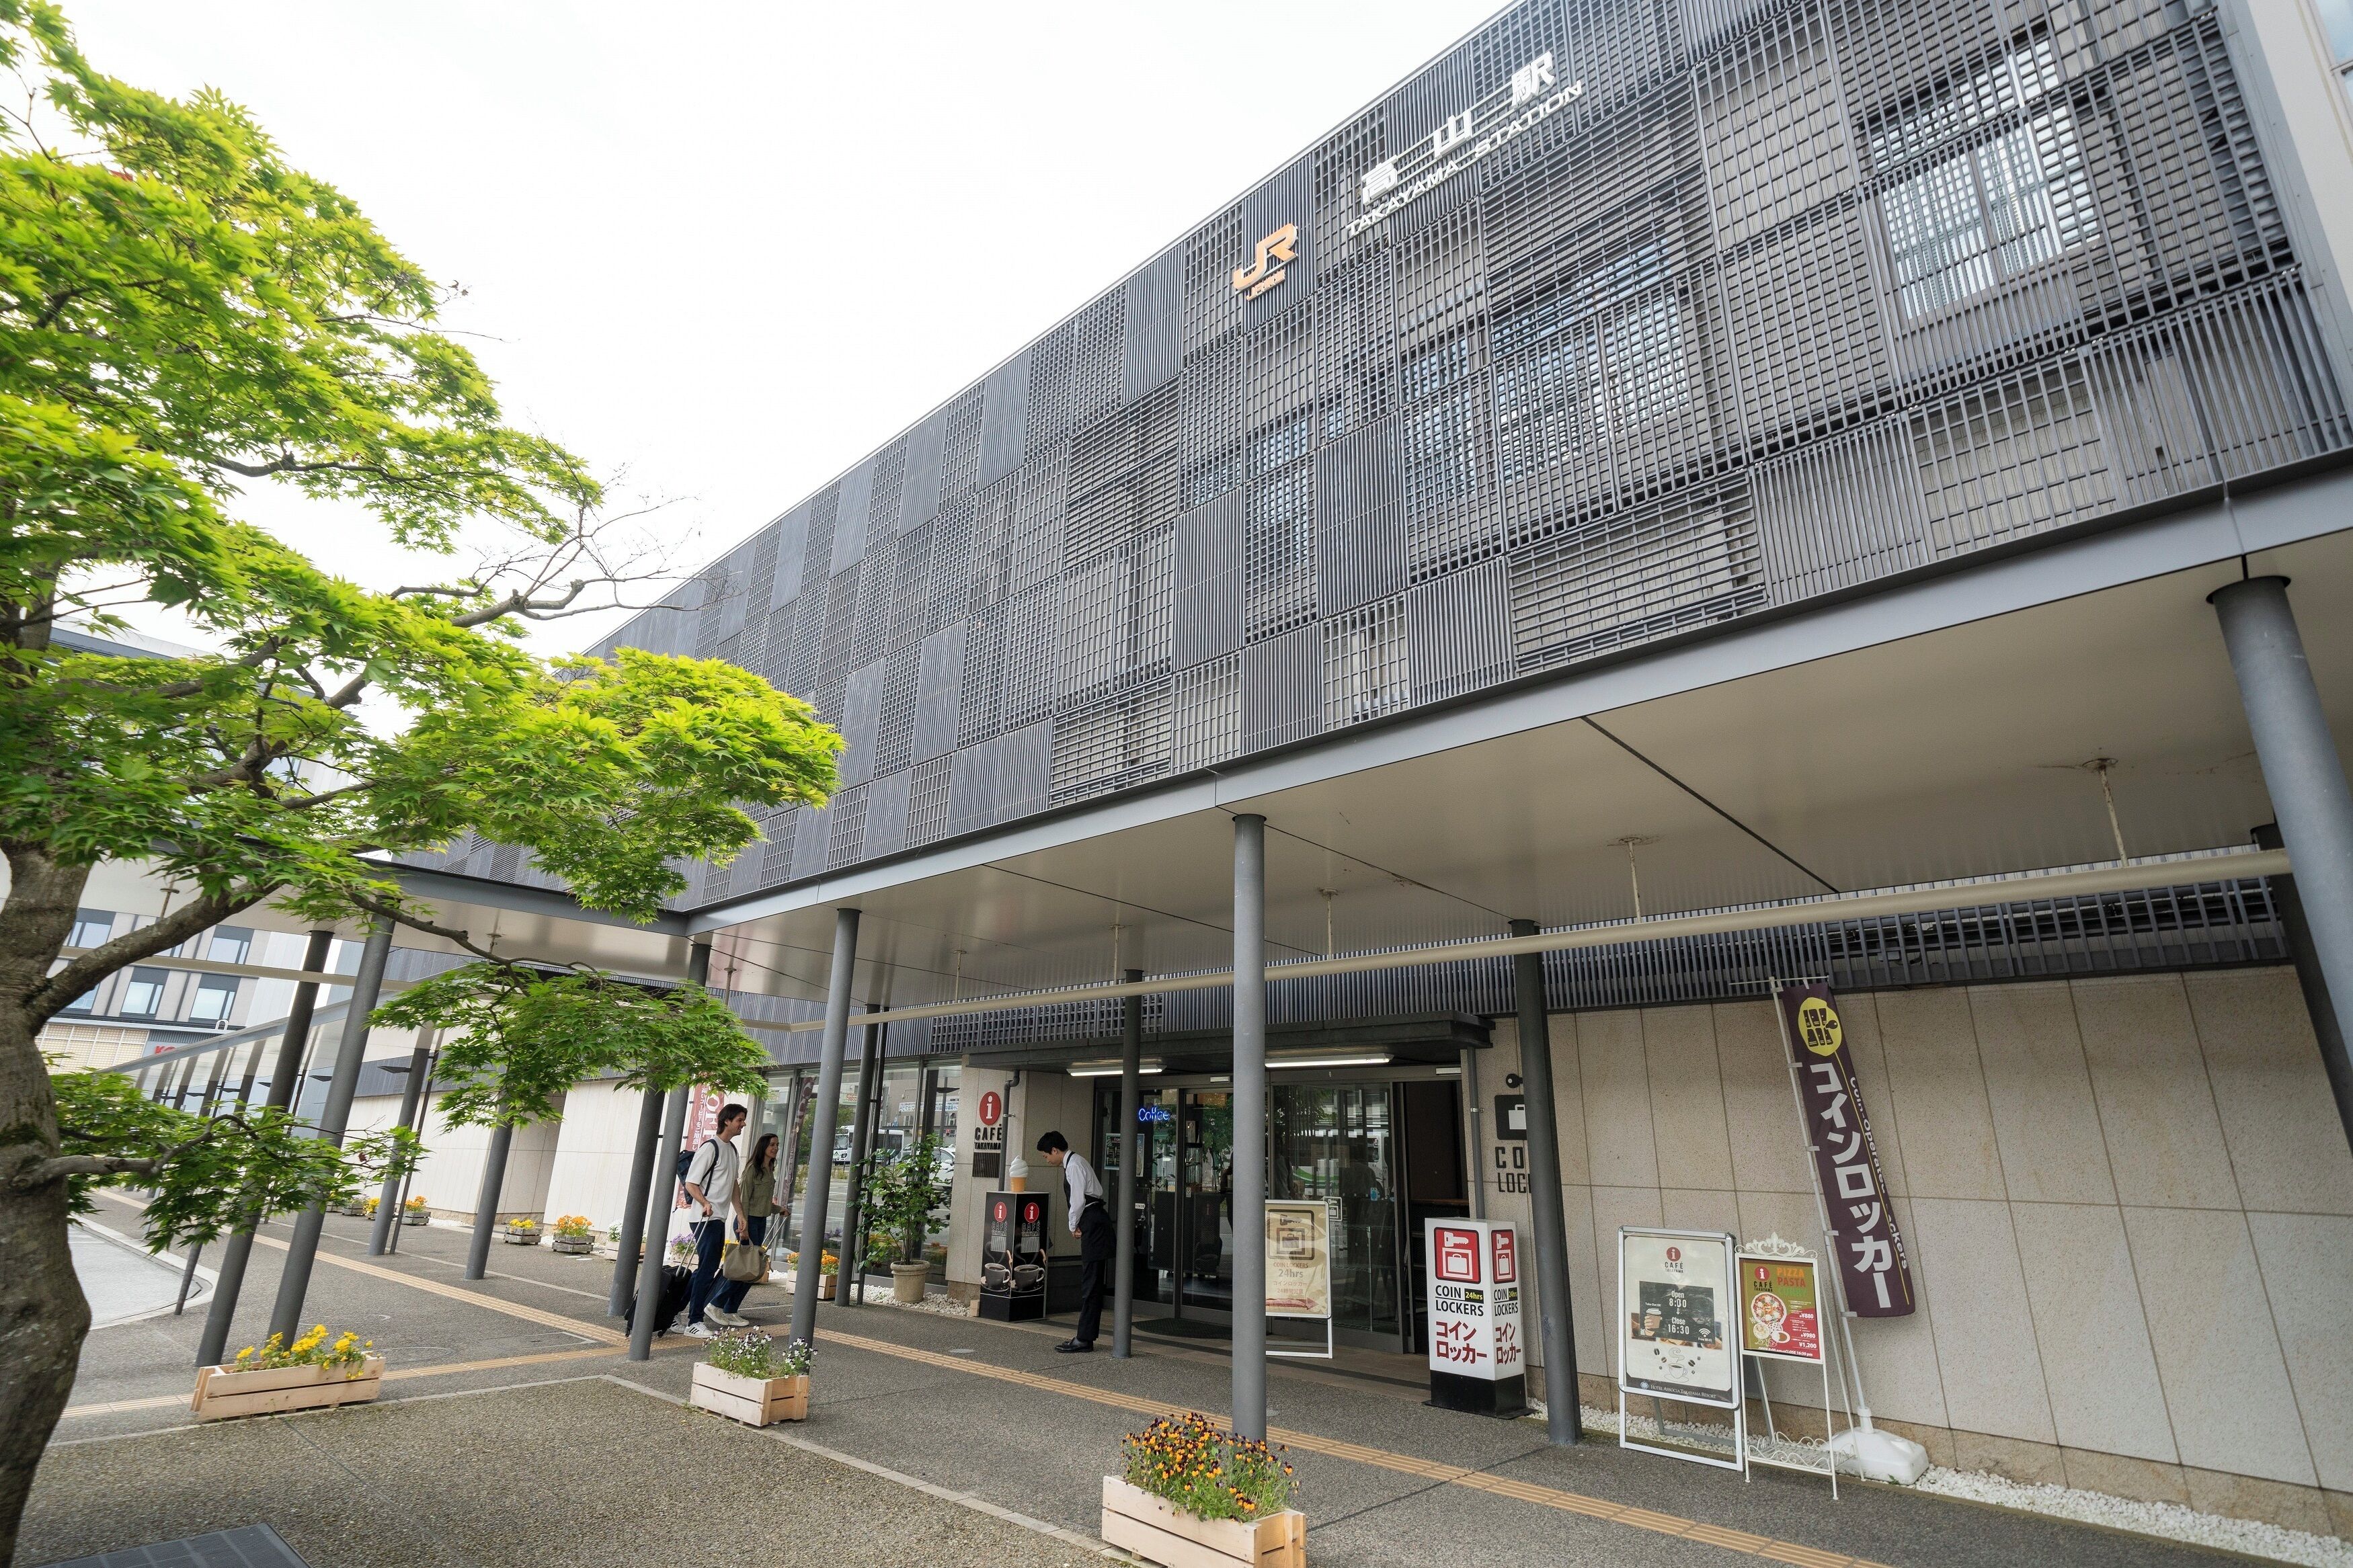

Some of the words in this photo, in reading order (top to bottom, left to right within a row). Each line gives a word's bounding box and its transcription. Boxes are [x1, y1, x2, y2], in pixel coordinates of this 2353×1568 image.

[1361, 51, 1555, 205] 高山駅
[1346, 160, 1459, 236] TAKAYAMA
[1474, 79, 1583, 159] STATION
[1233, 222, 1298, 290] JR
[1138, 1106, 1170, 1121] Coffee
[974, 1124, 1002, 1141] CAFÉ
[974, 1142, 1001, 1150] TAKAYAMA
[1809, 1062, 1892, 1309] コインロッカー
[991, 1220, 1008, 1231] CAFÉ
[1022, 1220, 1041, 1231] CAFÉ
[1278, 1268, 1304, 1278] 24hrs
[1777, 1267, 1804, 1278] PIZZA
[1753, 1280, 1773, 1288] CAFÉ
[1777, 1276, 1806, 1288] PASTA
[1435, 1285, 1461, 1298] COIN
[1465, 1291, 1483, 1301] 24hrs
[1494, 1288, 1507, 1301] COIN
[1671, 1290, 1684, 1298] Open
[1435, 1299, 1484, 1317] LOCKERS
[1494, 1302, 1519, 1317] LOCKERS
[1669, 1298, 1687, 1308] 8:00
[1671, 1317, 1685, 1325] Close
[1435, 1321, 1477, 1342] コイン
[1495, 1321, 1516, 1343] コイン
[1667, 1324, 1689, 1335] 16:30
[1436, 1340, 1487, 1364] ロッカー
[1496, 1342, 1521, 1365] ロッカー
